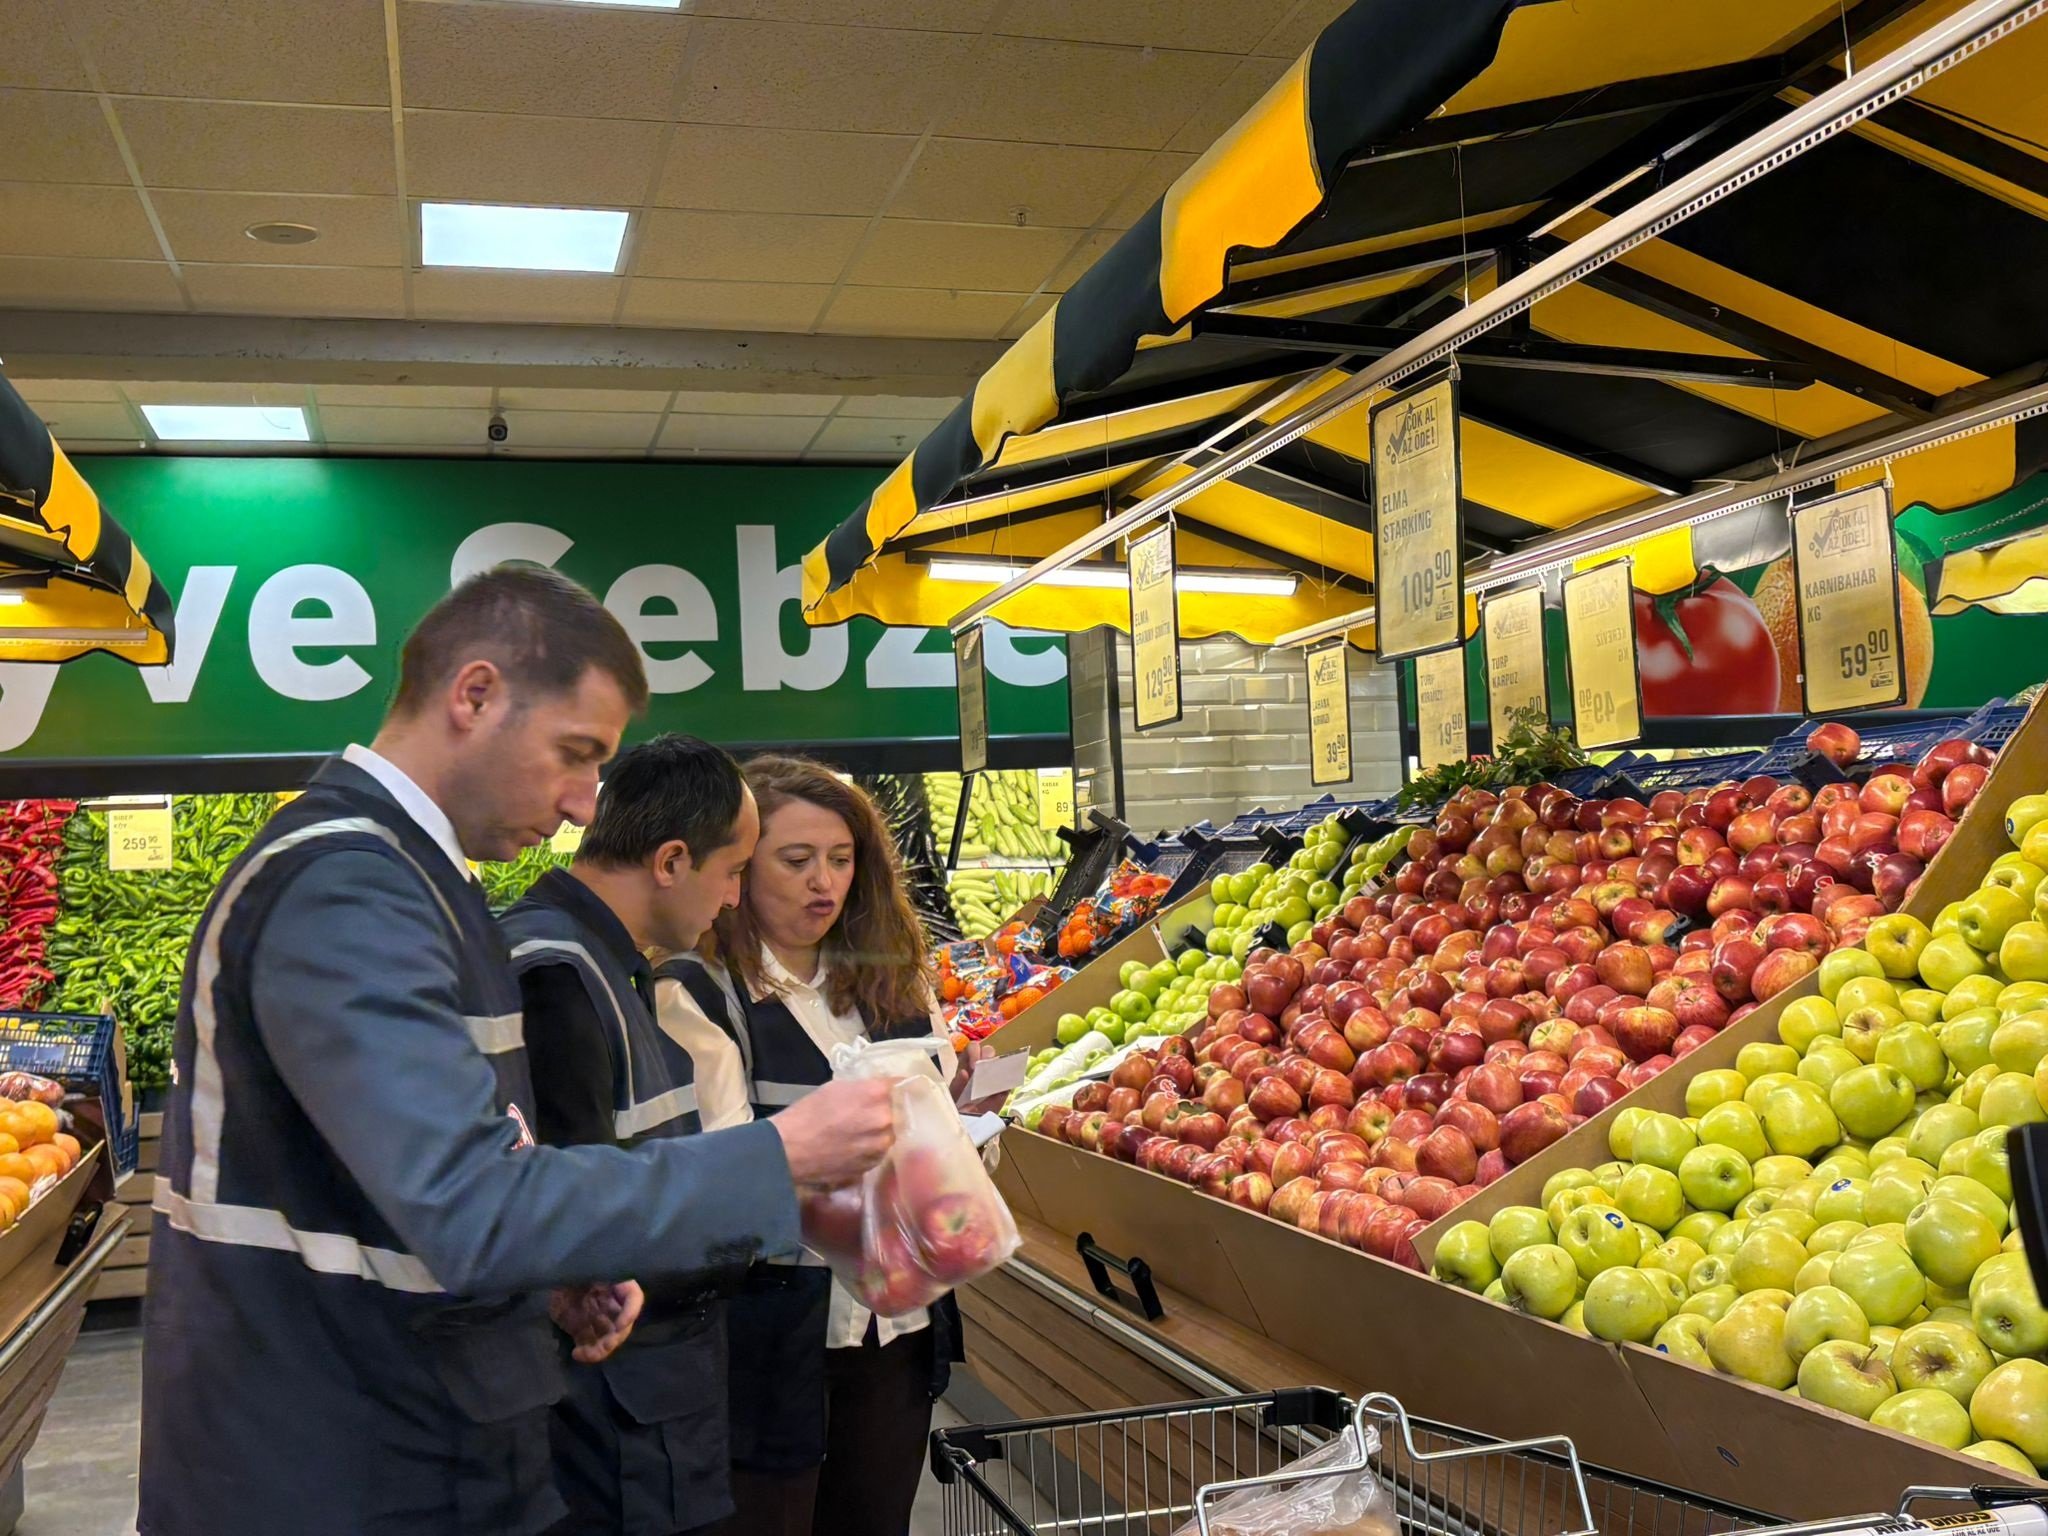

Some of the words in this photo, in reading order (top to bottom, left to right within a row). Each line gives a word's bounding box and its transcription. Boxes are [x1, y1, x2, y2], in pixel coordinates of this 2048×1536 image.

[1406, 410, 1423, 435] ÇOK
[1425, 404, 1436, 422] AL
[1402, 436, 1413, 456] AZ
[1414, 426, 1435, 450] ÖDE!
[1383, 489, 1408, 515] ELMA
[1383, 509, 1432, 543] STARKİNG
[1833, 514, 1851, 535] ÇOK
[1827, 536, 1840, 552] AZ
[1842, 529, 1866, 548] ÖDE!
[1401, 568, 1434, 613] 109
[1435, 549, 1451, 580] 90
[1805, 567, 1877, 599] KARNIBAHAR
[1807, 605, 1821, 623] KG
[1492, 655, 1508, 670] TURP
[1840, 643, 1867, 679] 59
[1868, 628, 1889, 654] 90
[1146, 667, 1163, 700] 129
[1163, 655, 1172, 677] 90
[1492, 671, 1519, 688] KARPUZ
[1439, 722, 1452, 746] 19
[1452, 713, 1463, 730] 90
[1327, 742, 1337, 763] 39
[1056, 801, 1069, 813] 89
[123, 837, 147, 850] 259
